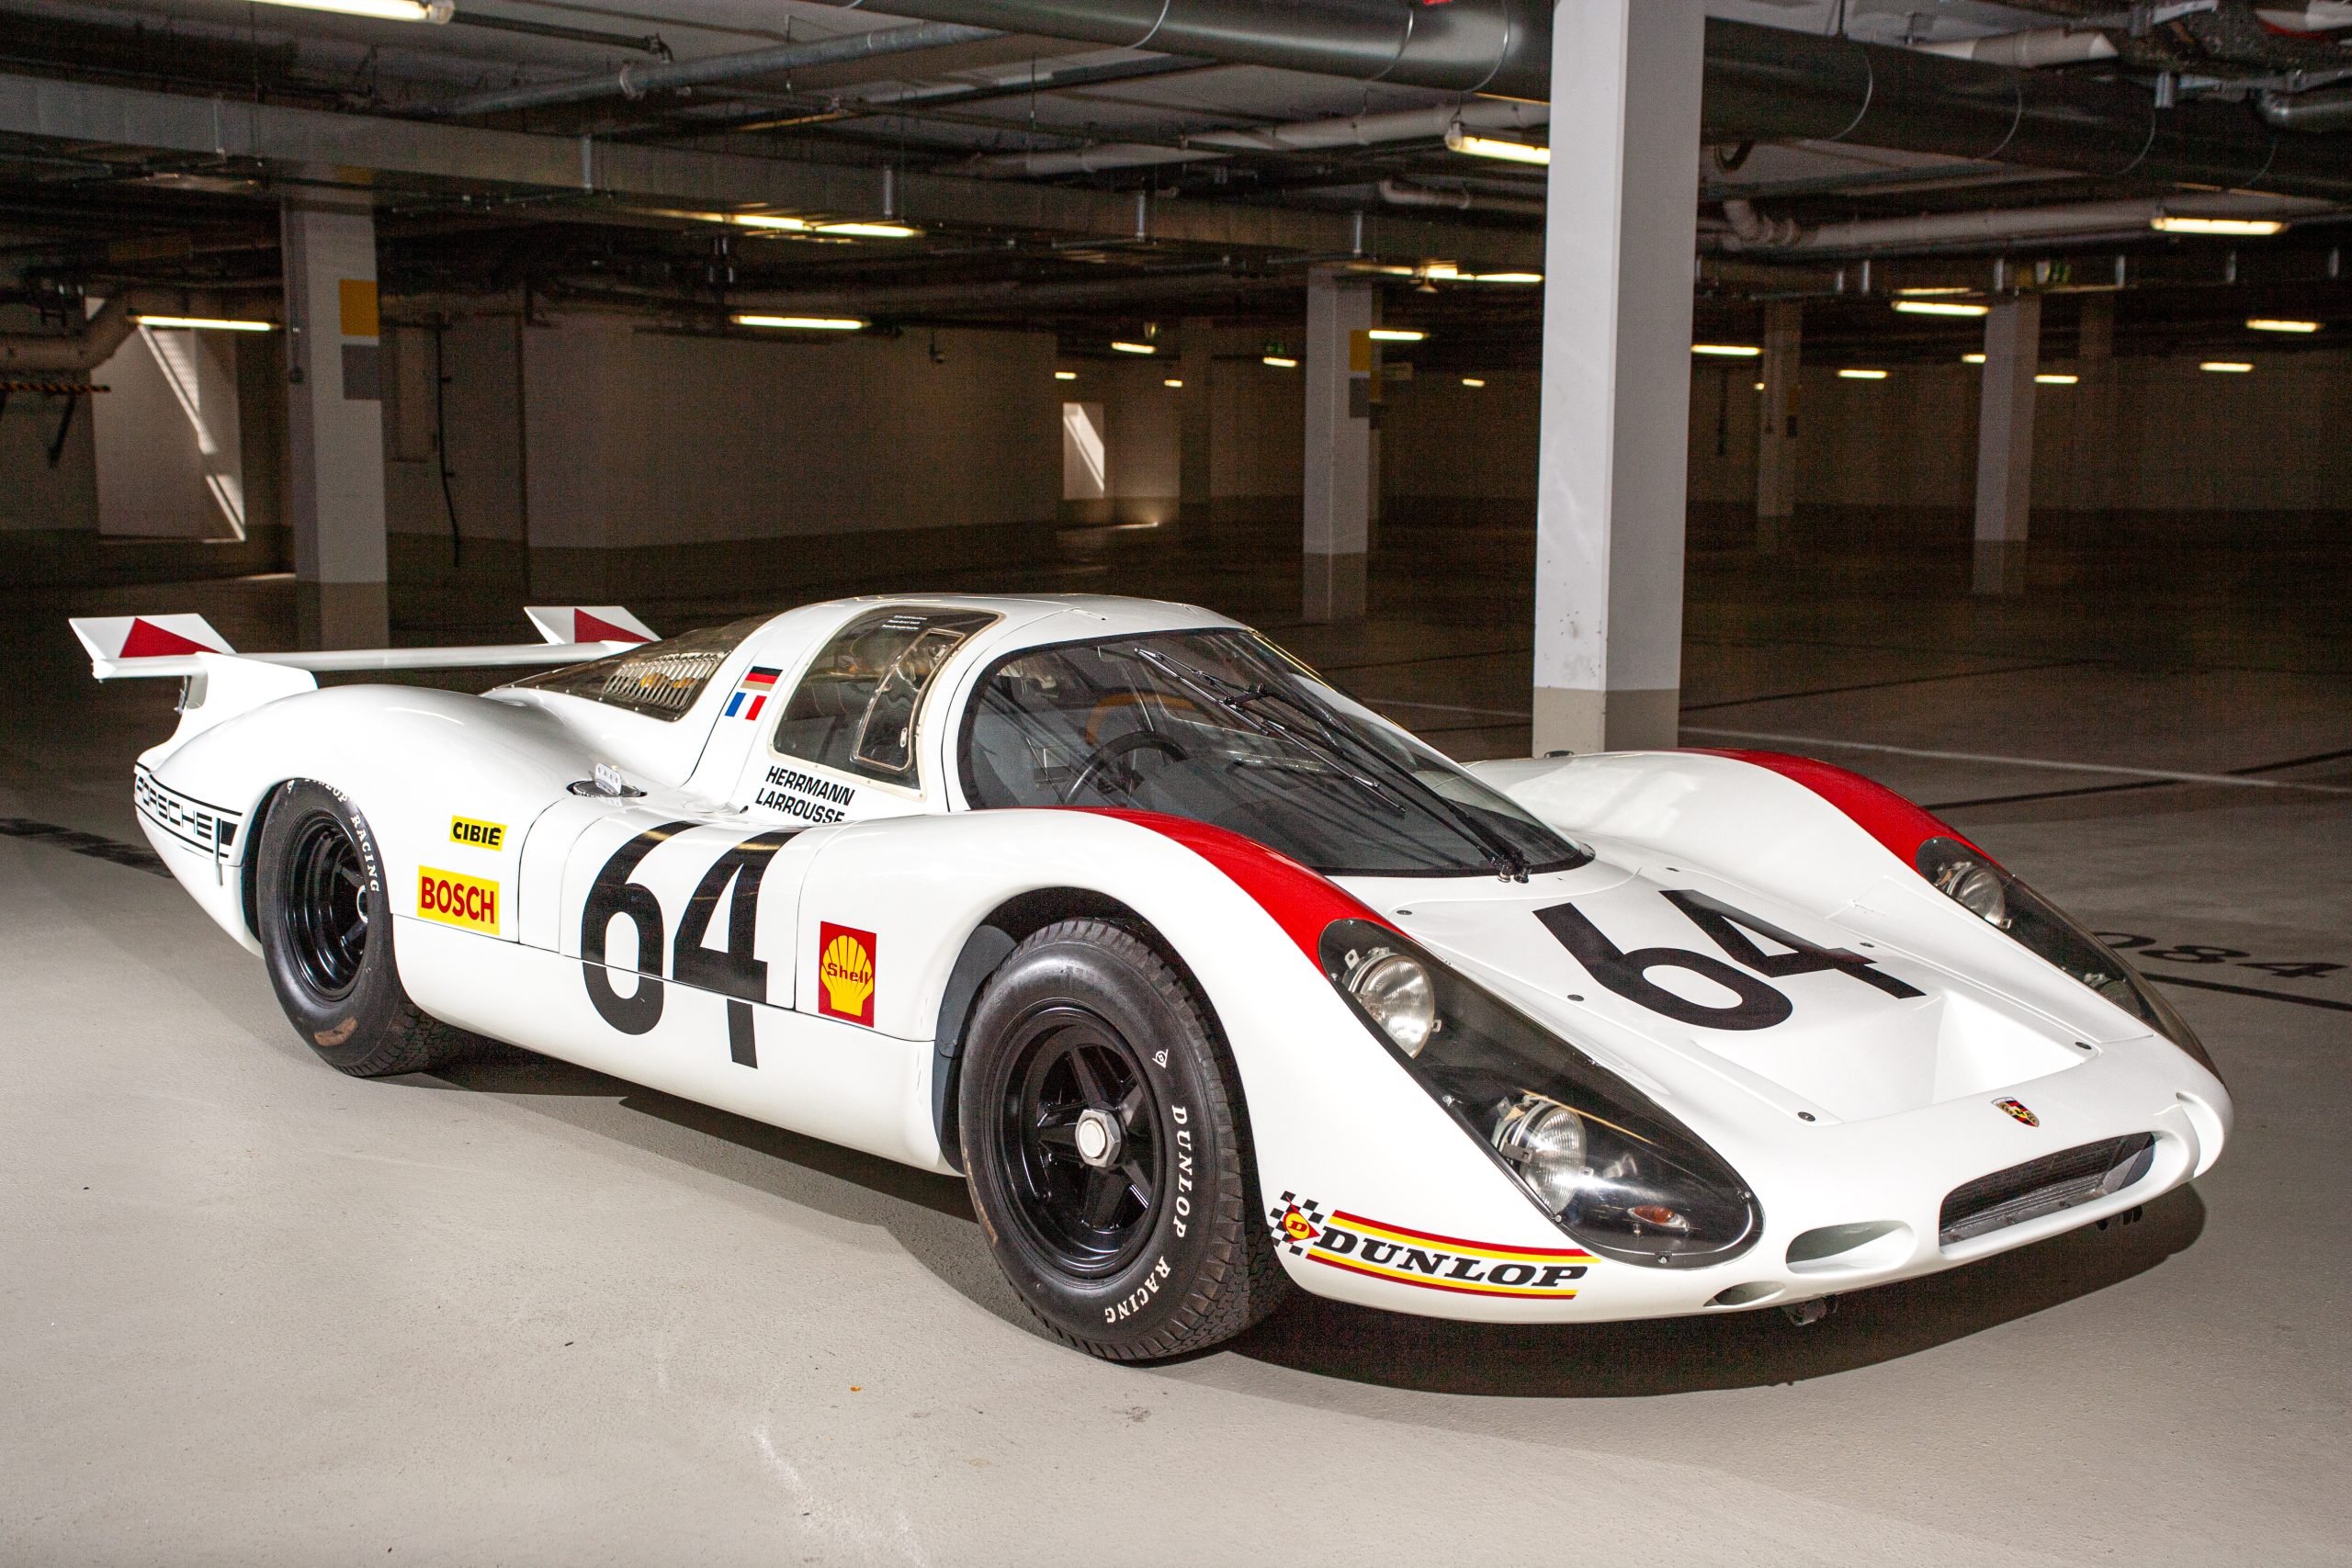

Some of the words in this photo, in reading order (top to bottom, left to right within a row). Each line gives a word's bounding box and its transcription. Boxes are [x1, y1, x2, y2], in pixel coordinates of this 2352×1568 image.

[755, 787, 845, 823] LARROUSSE
[765, 766, 855, 807] HERRMANN
[351, 815, 379, 892] RACING
[421, 875, 495, 924] BOSCH
[581, 820, 812, 1069] 64
[827, 962, 868, 985] Shell
[1532, 888, 1927, 1031] 64
[1171, 1104, 1193, 1238] DUNLOP
[1313, 1225, 1589, 1288] DUNLOP
[1104, 1256, 1171, 1324] RACING
